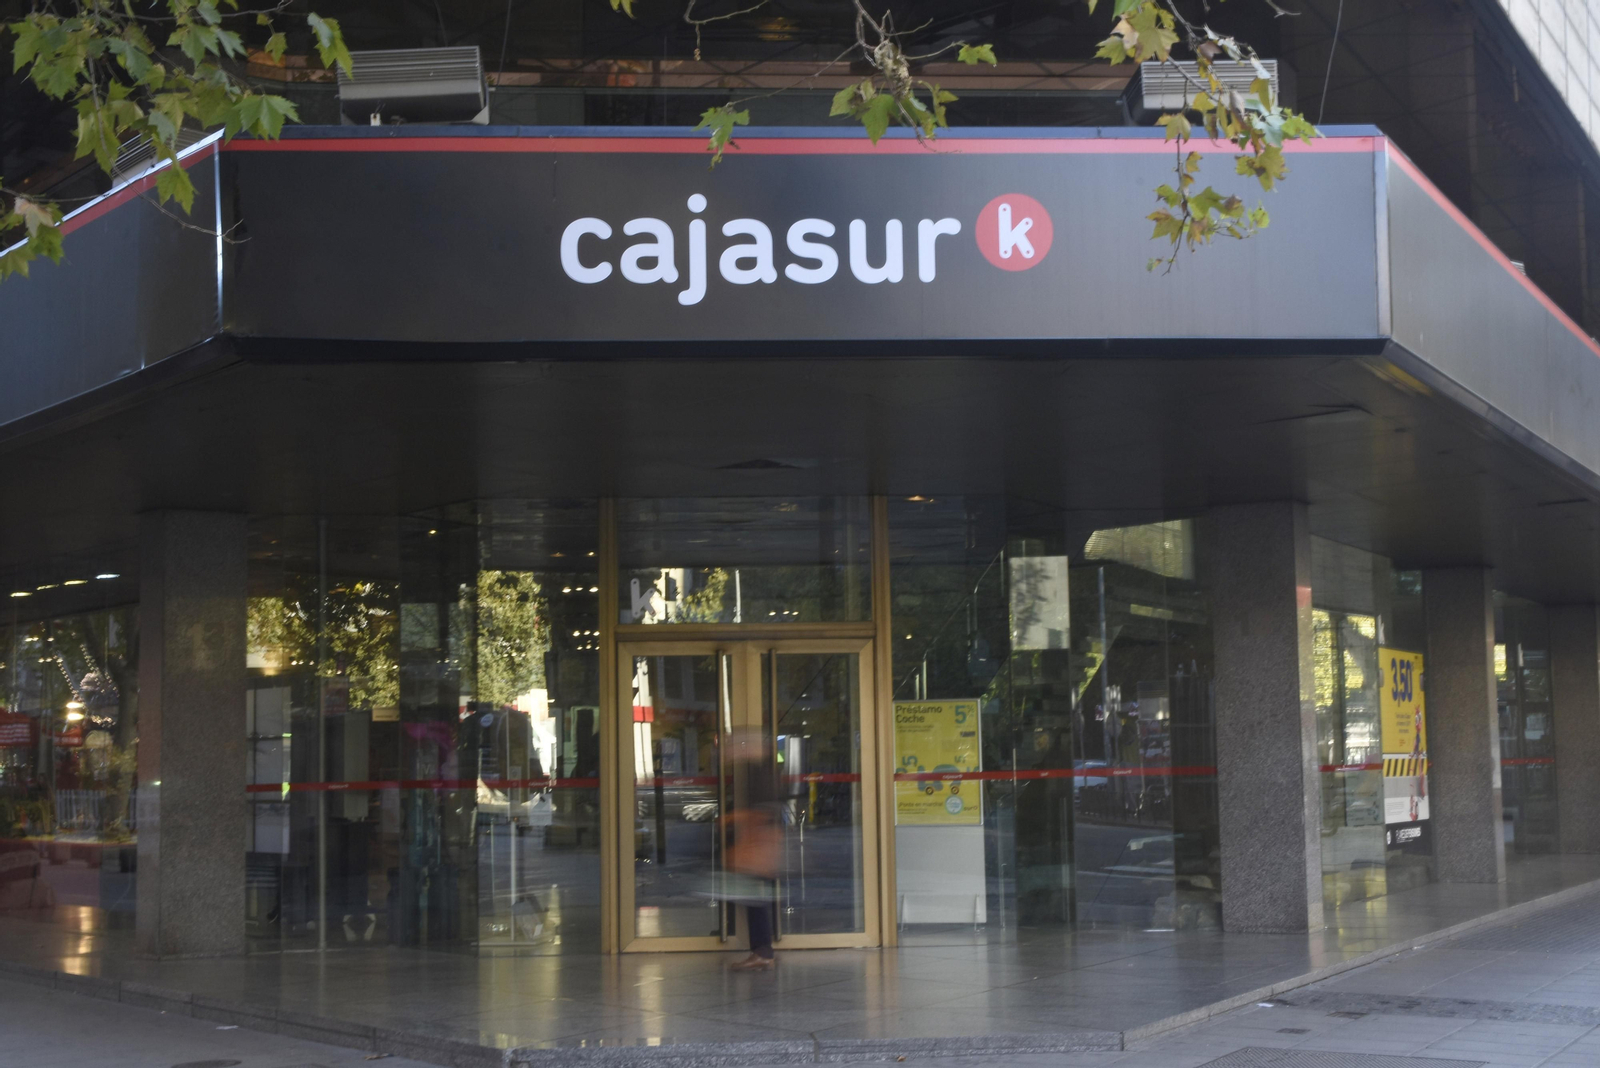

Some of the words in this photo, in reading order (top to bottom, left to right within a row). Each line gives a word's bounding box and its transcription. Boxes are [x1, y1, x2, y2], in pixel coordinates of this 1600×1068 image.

[560, 193, 961, 306] cajasur
[997, 203, 1035, 260] k
[896, 705, 942, 714] Préstamo
[896, 714, 924, 723] Coche
